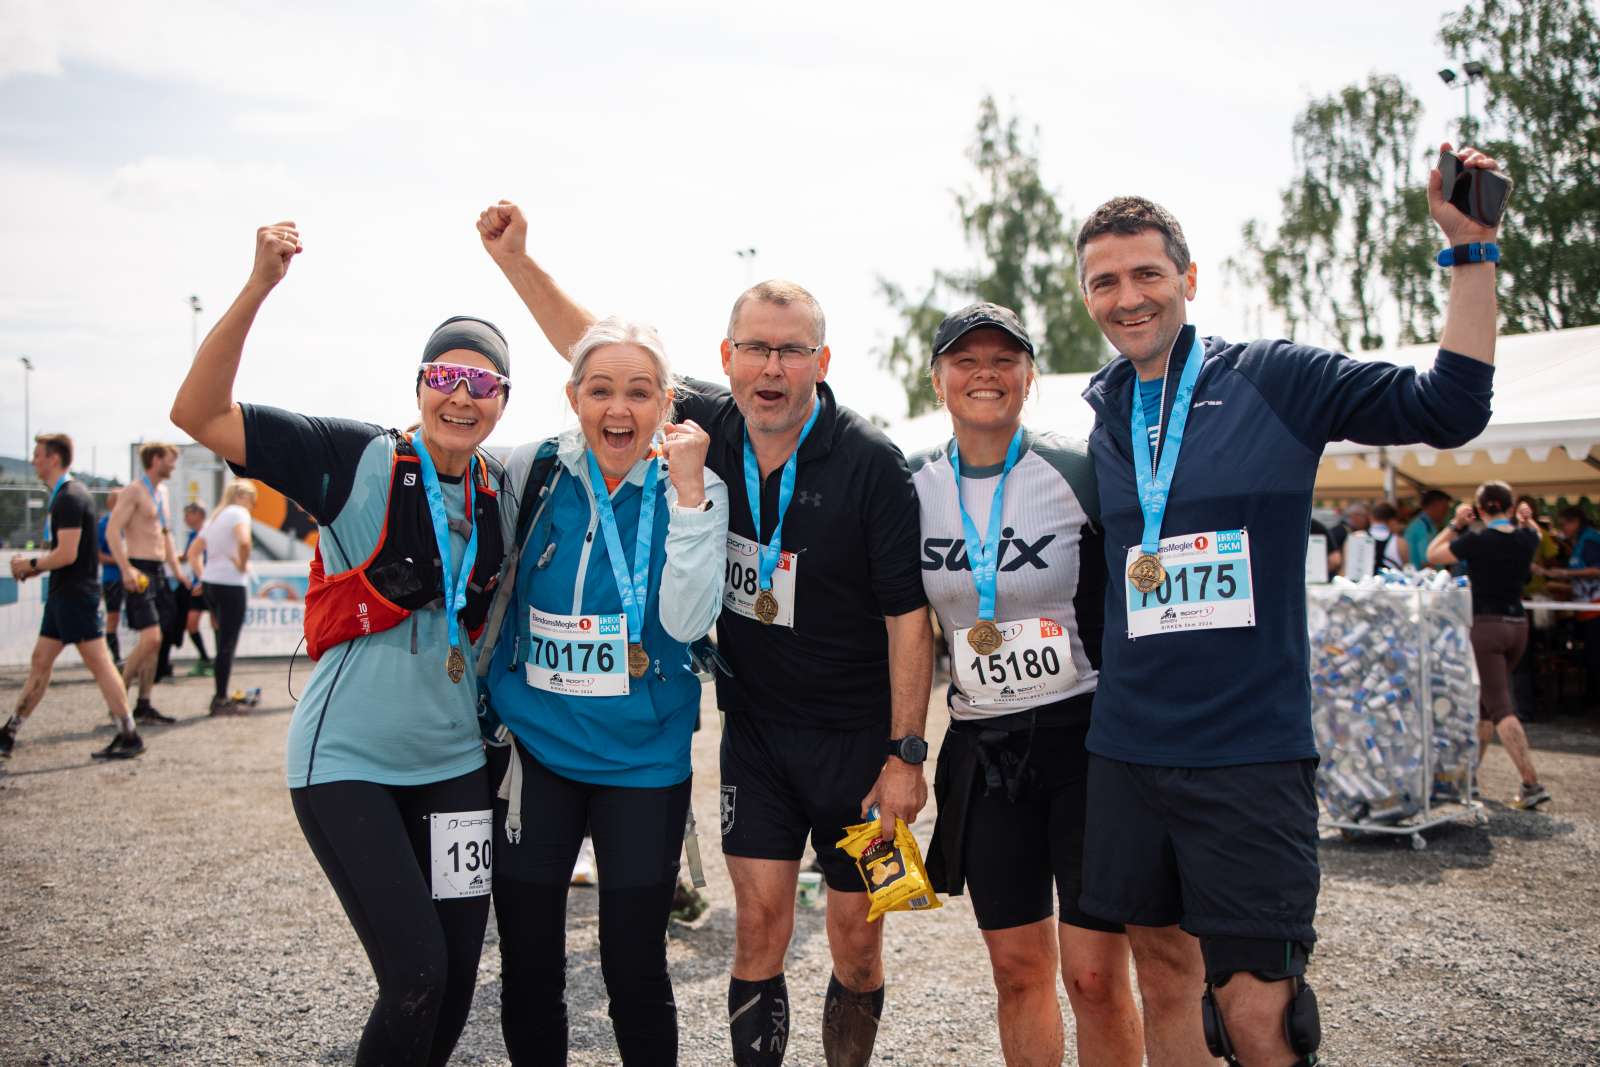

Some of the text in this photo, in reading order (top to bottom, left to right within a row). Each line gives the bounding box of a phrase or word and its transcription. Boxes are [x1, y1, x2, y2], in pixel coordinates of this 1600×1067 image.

[1218, 542, 1241, 552] 5KM
[357, 602, 368, 614] 10
[532, 636, 614, 673] 70176
[970, 646, 1060, 686] 15180
[447, 839, 491, 873] 130
